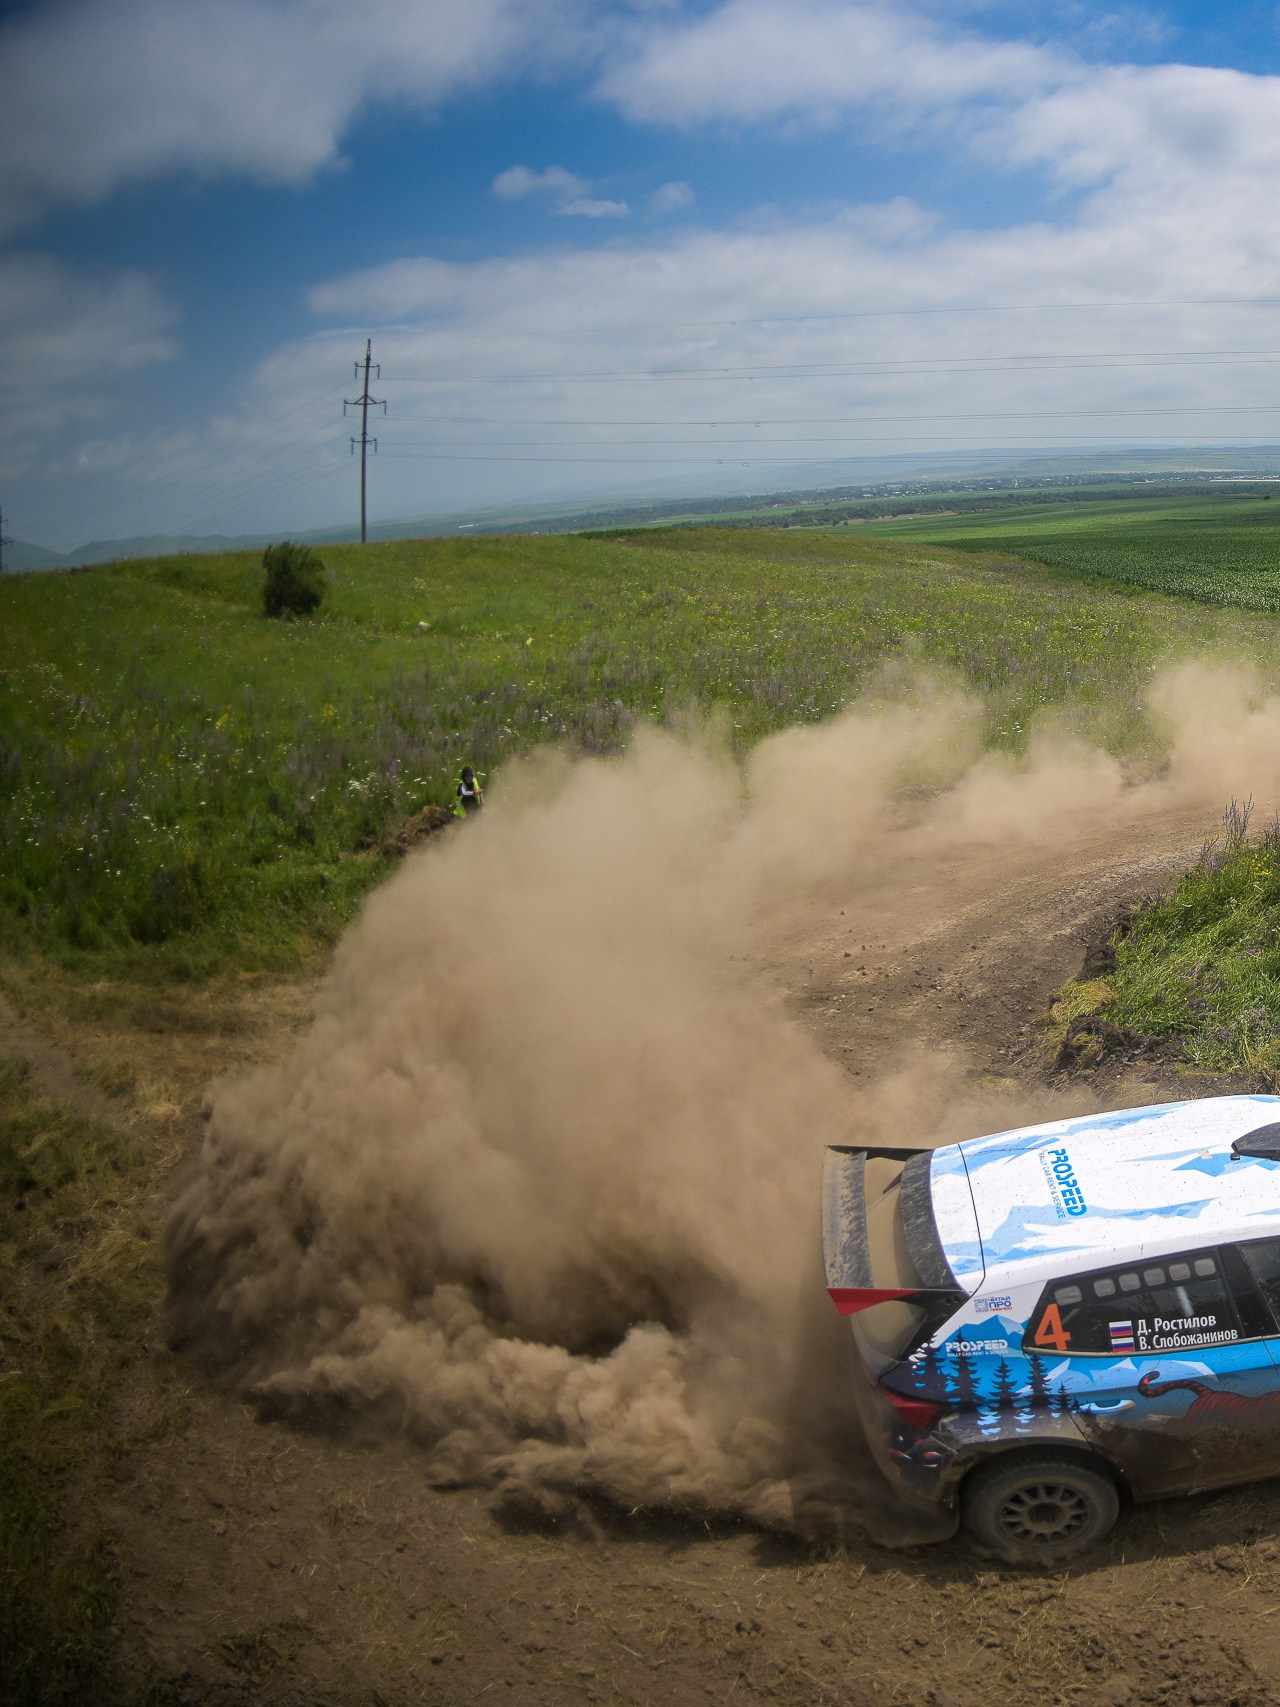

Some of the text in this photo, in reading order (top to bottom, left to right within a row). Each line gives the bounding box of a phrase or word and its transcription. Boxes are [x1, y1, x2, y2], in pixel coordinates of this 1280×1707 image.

[1048, 1148, 1088, 1217] PROSPEED
[988, 1300, 1012, 1308] ПРО
[1034, 1303, 1072, 1351] 4
[1137, 1315, 1217, 1336] Д. Ростилов
[945, 1339, 1009, 1353] PROSPEED
[1139, 1329, 1239, 1350] В. Слобожанинов
